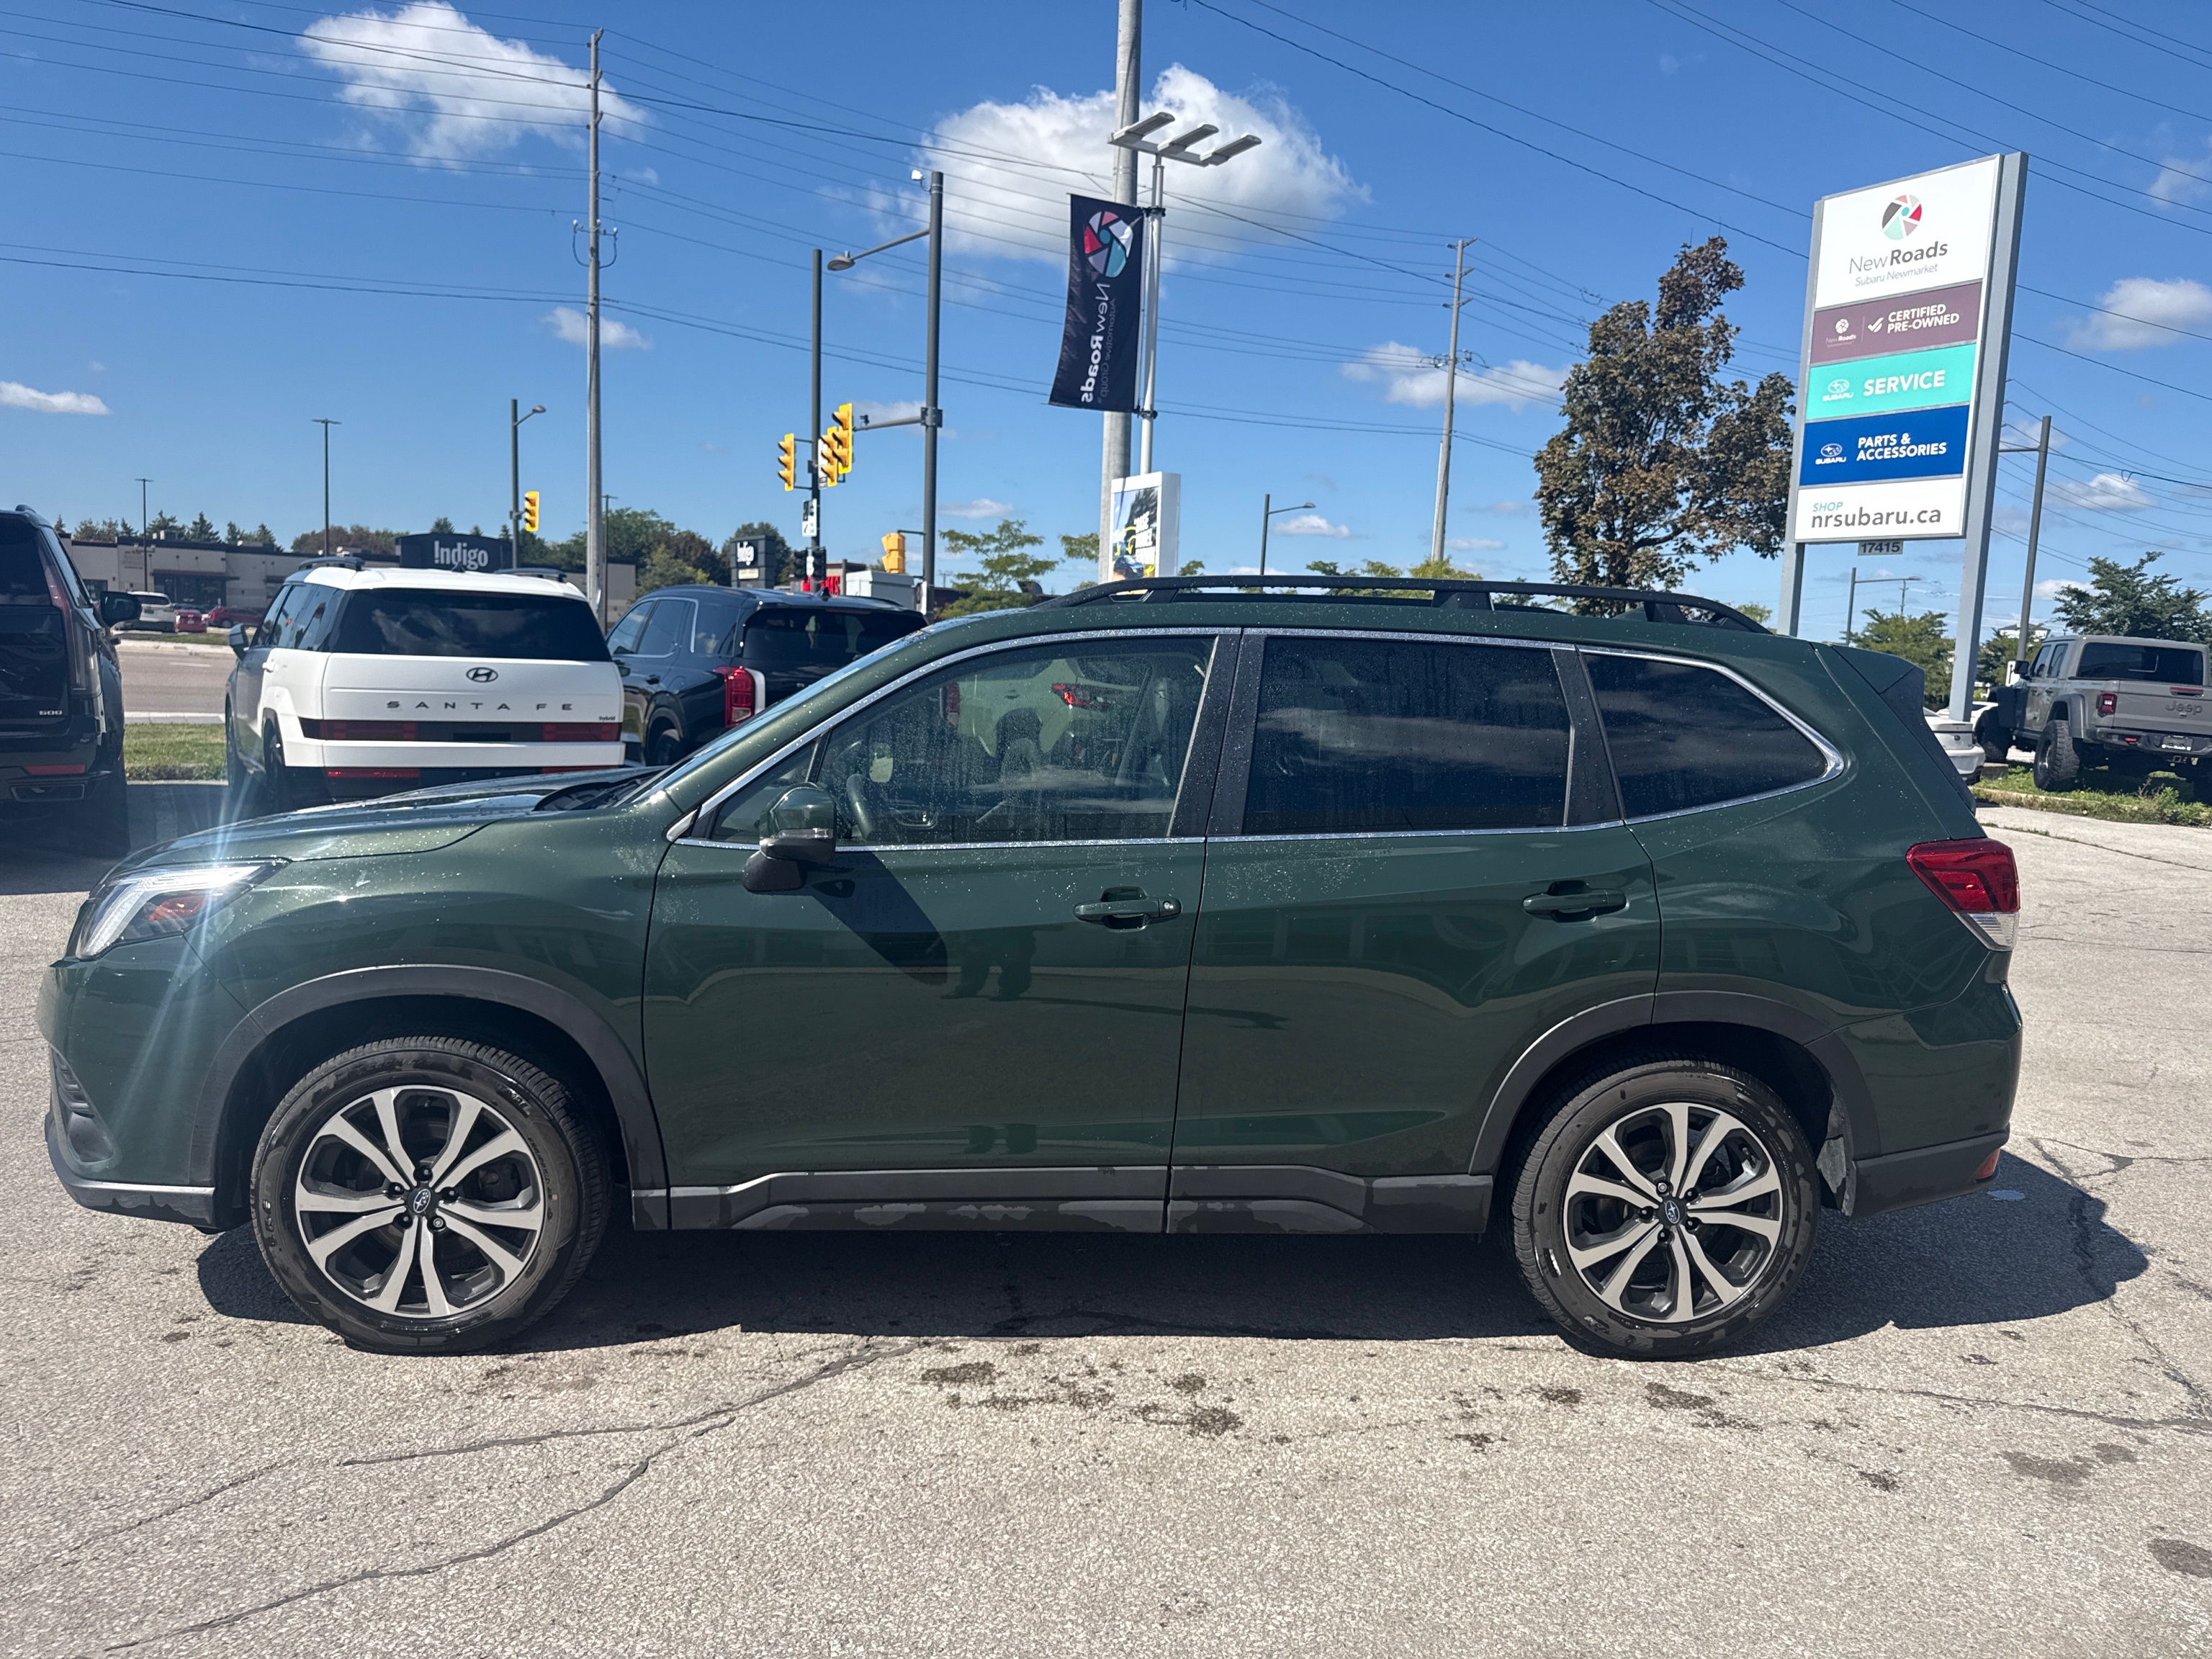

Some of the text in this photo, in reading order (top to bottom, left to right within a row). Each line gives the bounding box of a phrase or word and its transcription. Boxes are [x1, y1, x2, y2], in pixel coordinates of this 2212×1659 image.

[1854, 263, 1938, 287] Subaru Newmarket
[1887, 304, 1946, 323] CERTIFIED
[1887, 313, 1960, 334] PRE-OWNED
[1863, 370, 1946, 397] SERVICE
[1822, 392, 1854, 402] SUBARU
[1857, 433, 1911, 449] PARTS &
[1856, 442, 1948, 462] ACCESSORIES
[1815, 457, 1847, 465] SUBARU
[1812, 501, 1844, 513] SHOP
[1811, 506, 1942, 529] nrsubaru.ca
[1860, 541, 1901, 554] 17415
[387, 701, 572, 711] SANTA FE
[2166, 700, 2202, 715] Jeep
